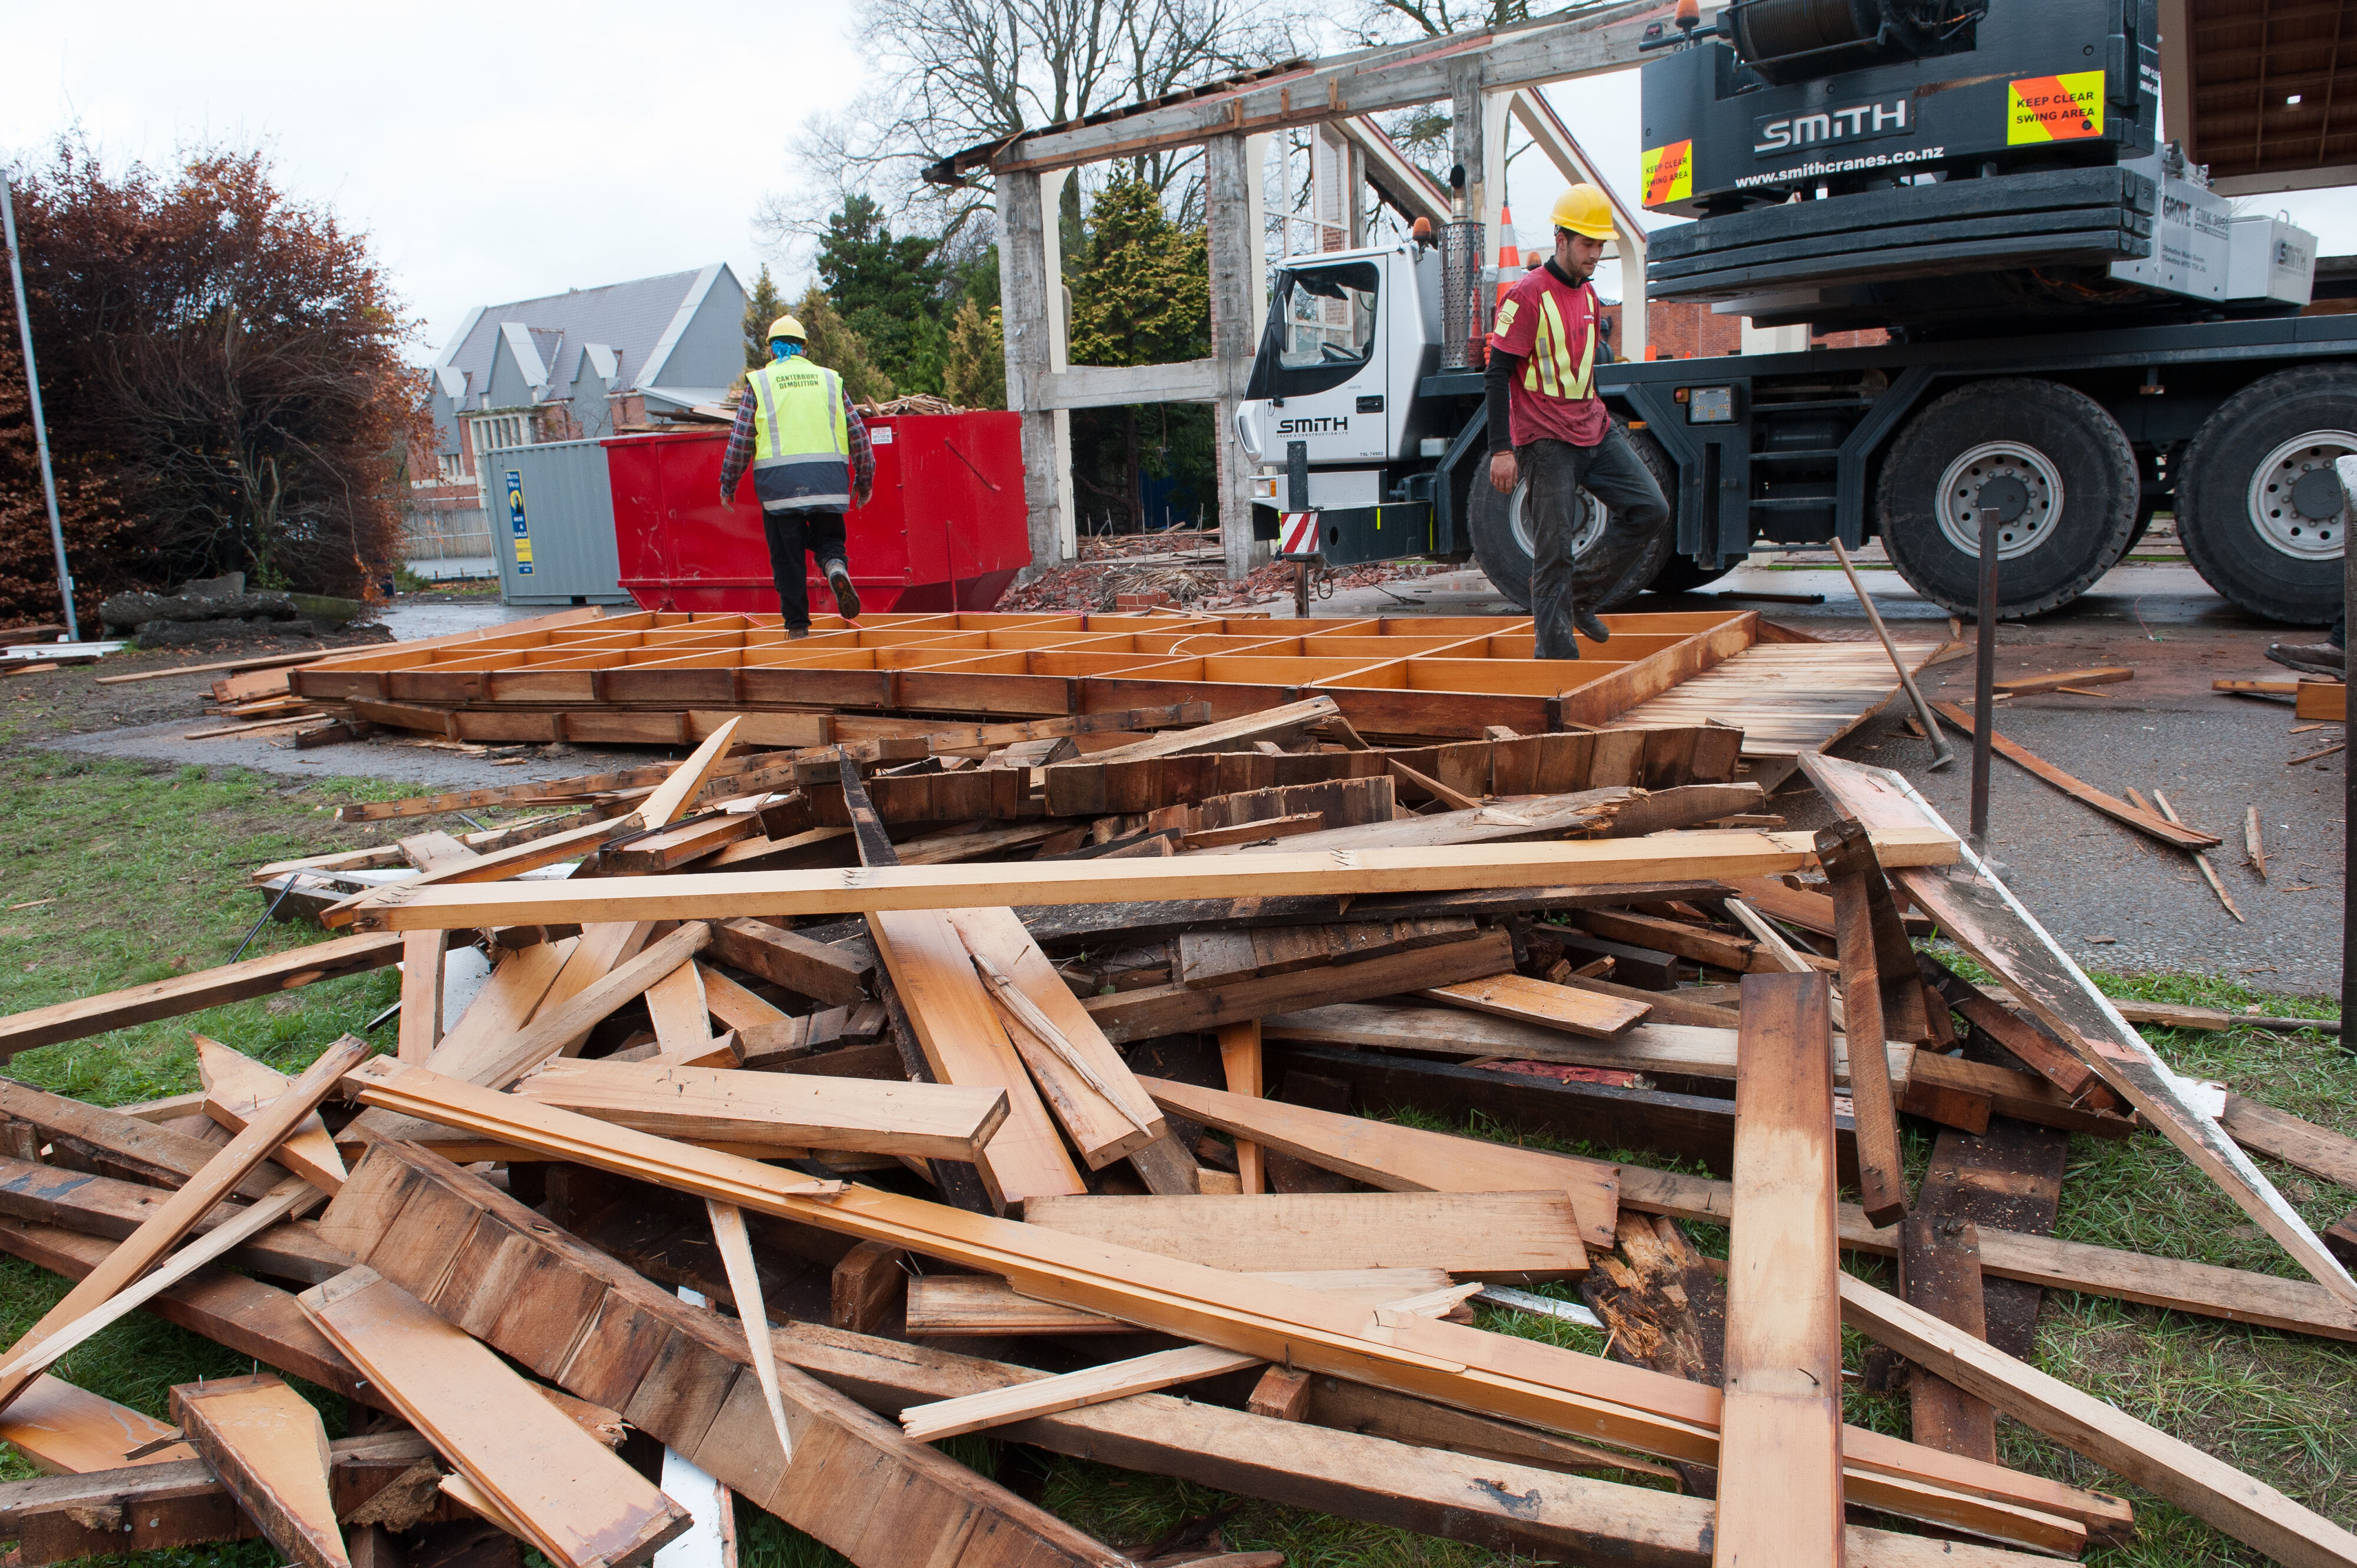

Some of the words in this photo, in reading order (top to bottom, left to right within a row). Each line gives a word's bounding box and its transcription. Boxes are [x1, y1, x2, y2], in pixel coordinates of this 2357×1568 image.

[2017, 97, 2049, 108] KEEP
[2053, 91, 2094, 104] CLEAR
[2016, 111, 2057, 124] SWING
[2061, 108, 2094, 119] AREA
[1754, 99, 1906, 153] SMITH
[1646, 163, 1663, 174] KEEP
[1664, 157, 1687, 169] CLEAR
[1735, 147, 1944, 188] www.smithcranes.co.nz
[1646, 176, 1667, 188] SWING
[1670, 170, 1688, 181] AREA
[2163, 195, 2191, 227] GROVE
[776, 374, 819, 382] CANTERBURY
[779, 380, 819, 389] DEMOLITION
[1277, 416, 1348, 434] SMITH
